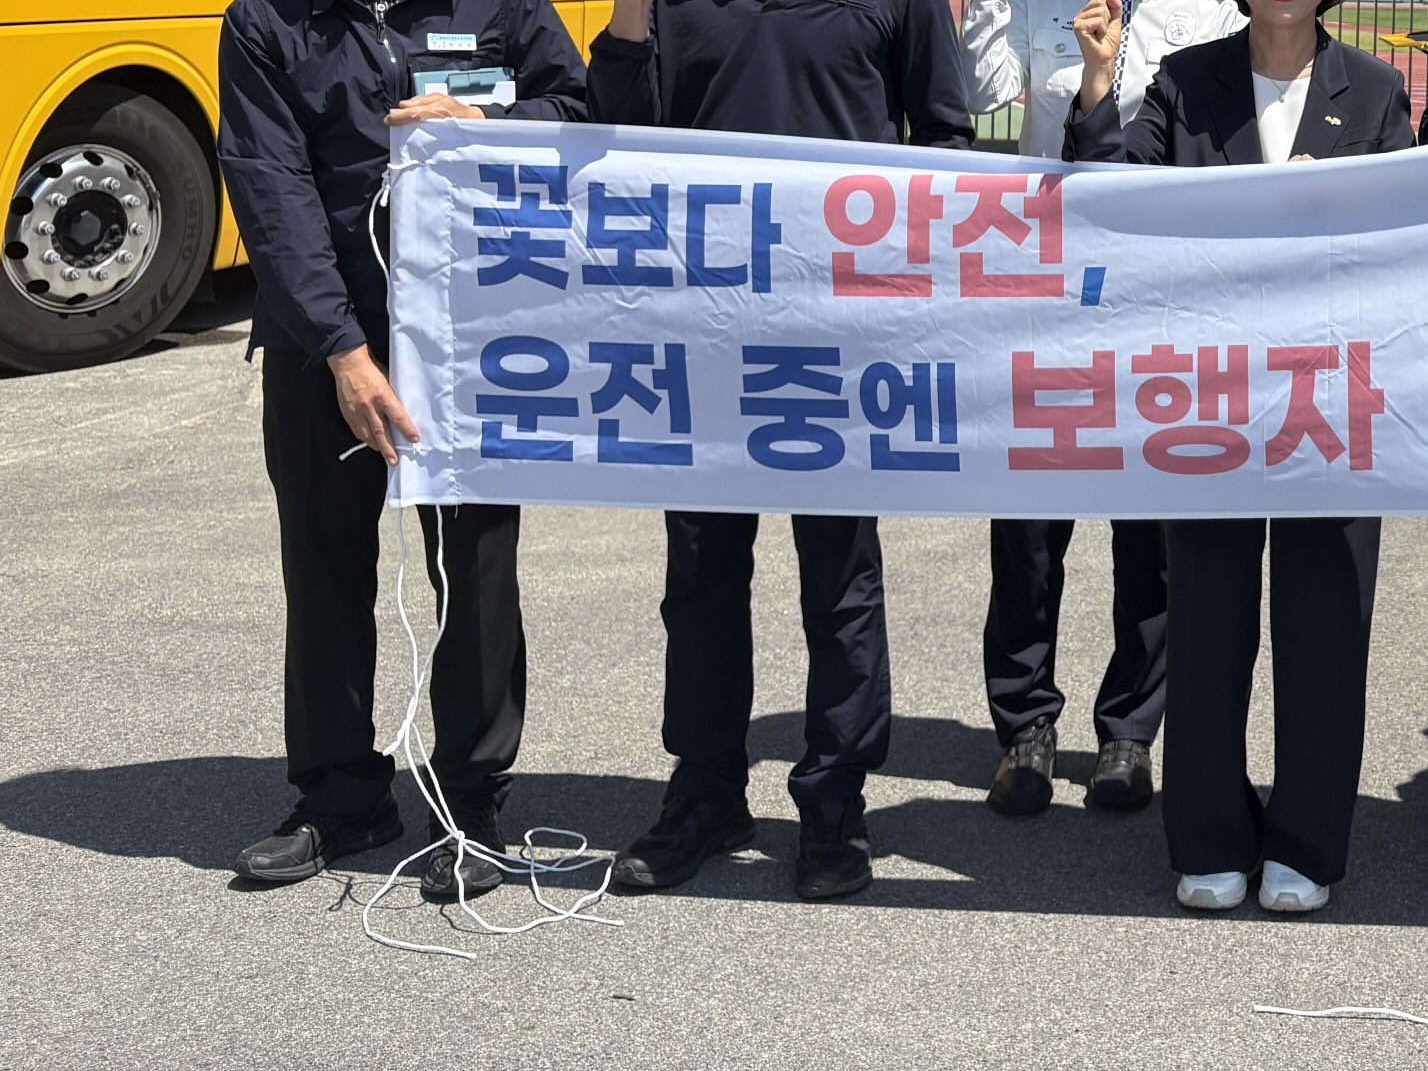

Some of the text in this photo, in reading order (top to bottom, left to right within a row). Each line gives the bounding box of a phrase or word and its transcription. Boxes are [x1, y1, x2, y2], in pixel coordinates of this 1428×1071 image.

[473, 164, 1107, 307] 꽃보다 안전,
[475, 335, 694, 466] 운전
[739, 345, 961, 472] 중엔
[1008, 340, 1385, 476] 보행자
